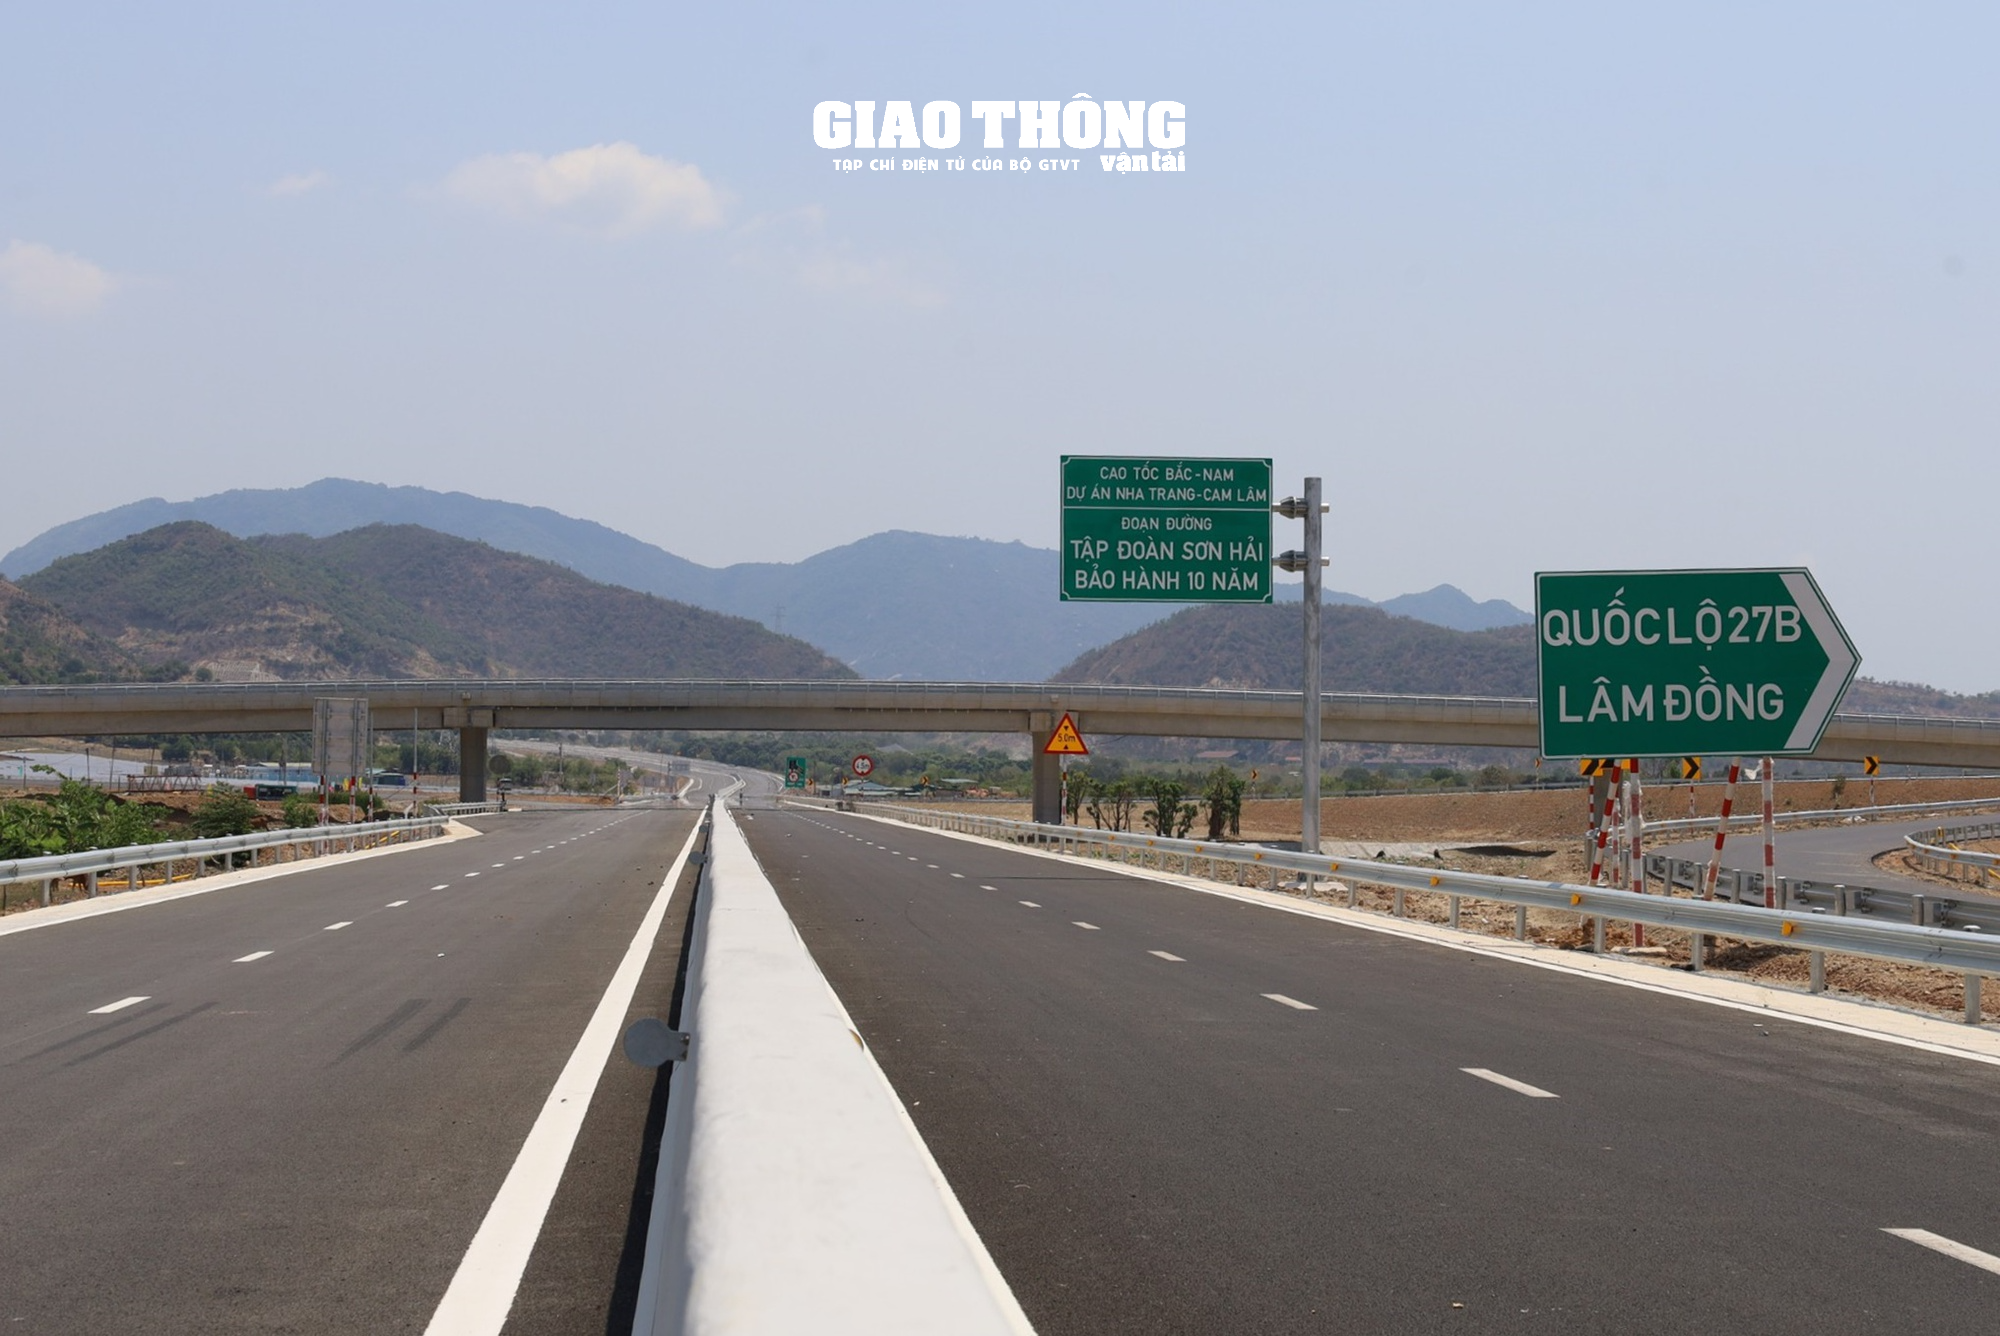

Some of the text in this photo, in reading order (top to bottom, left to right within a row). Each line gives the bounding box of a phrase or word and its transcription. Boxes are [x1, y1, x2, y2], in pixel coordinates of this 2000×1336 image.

[1100, 466, 1127, 480] CAO
[1133, 461, 1159, 480] TỐC
[1066, 486, 1087, 500] DỰ
[1090, 483, 1111, 500] ÁN
[1116, 487, 1145, 501] NHA
[1237, 486, 1267, 502] LÂM
[1121, 513, 1213, 533] ĐOẠN ĐƯỜNG
[1070, 536, 1263, 562] TẬP ĐOÀN SƠN HẢI
[1075, 563, 1259, 591] BẢO HÀNH 10 NĂM
[1543, 586, 1802, 651] QUỐC LỘ 27B
[1559, 665, 1784, 723] LÂM ĐỒNG
